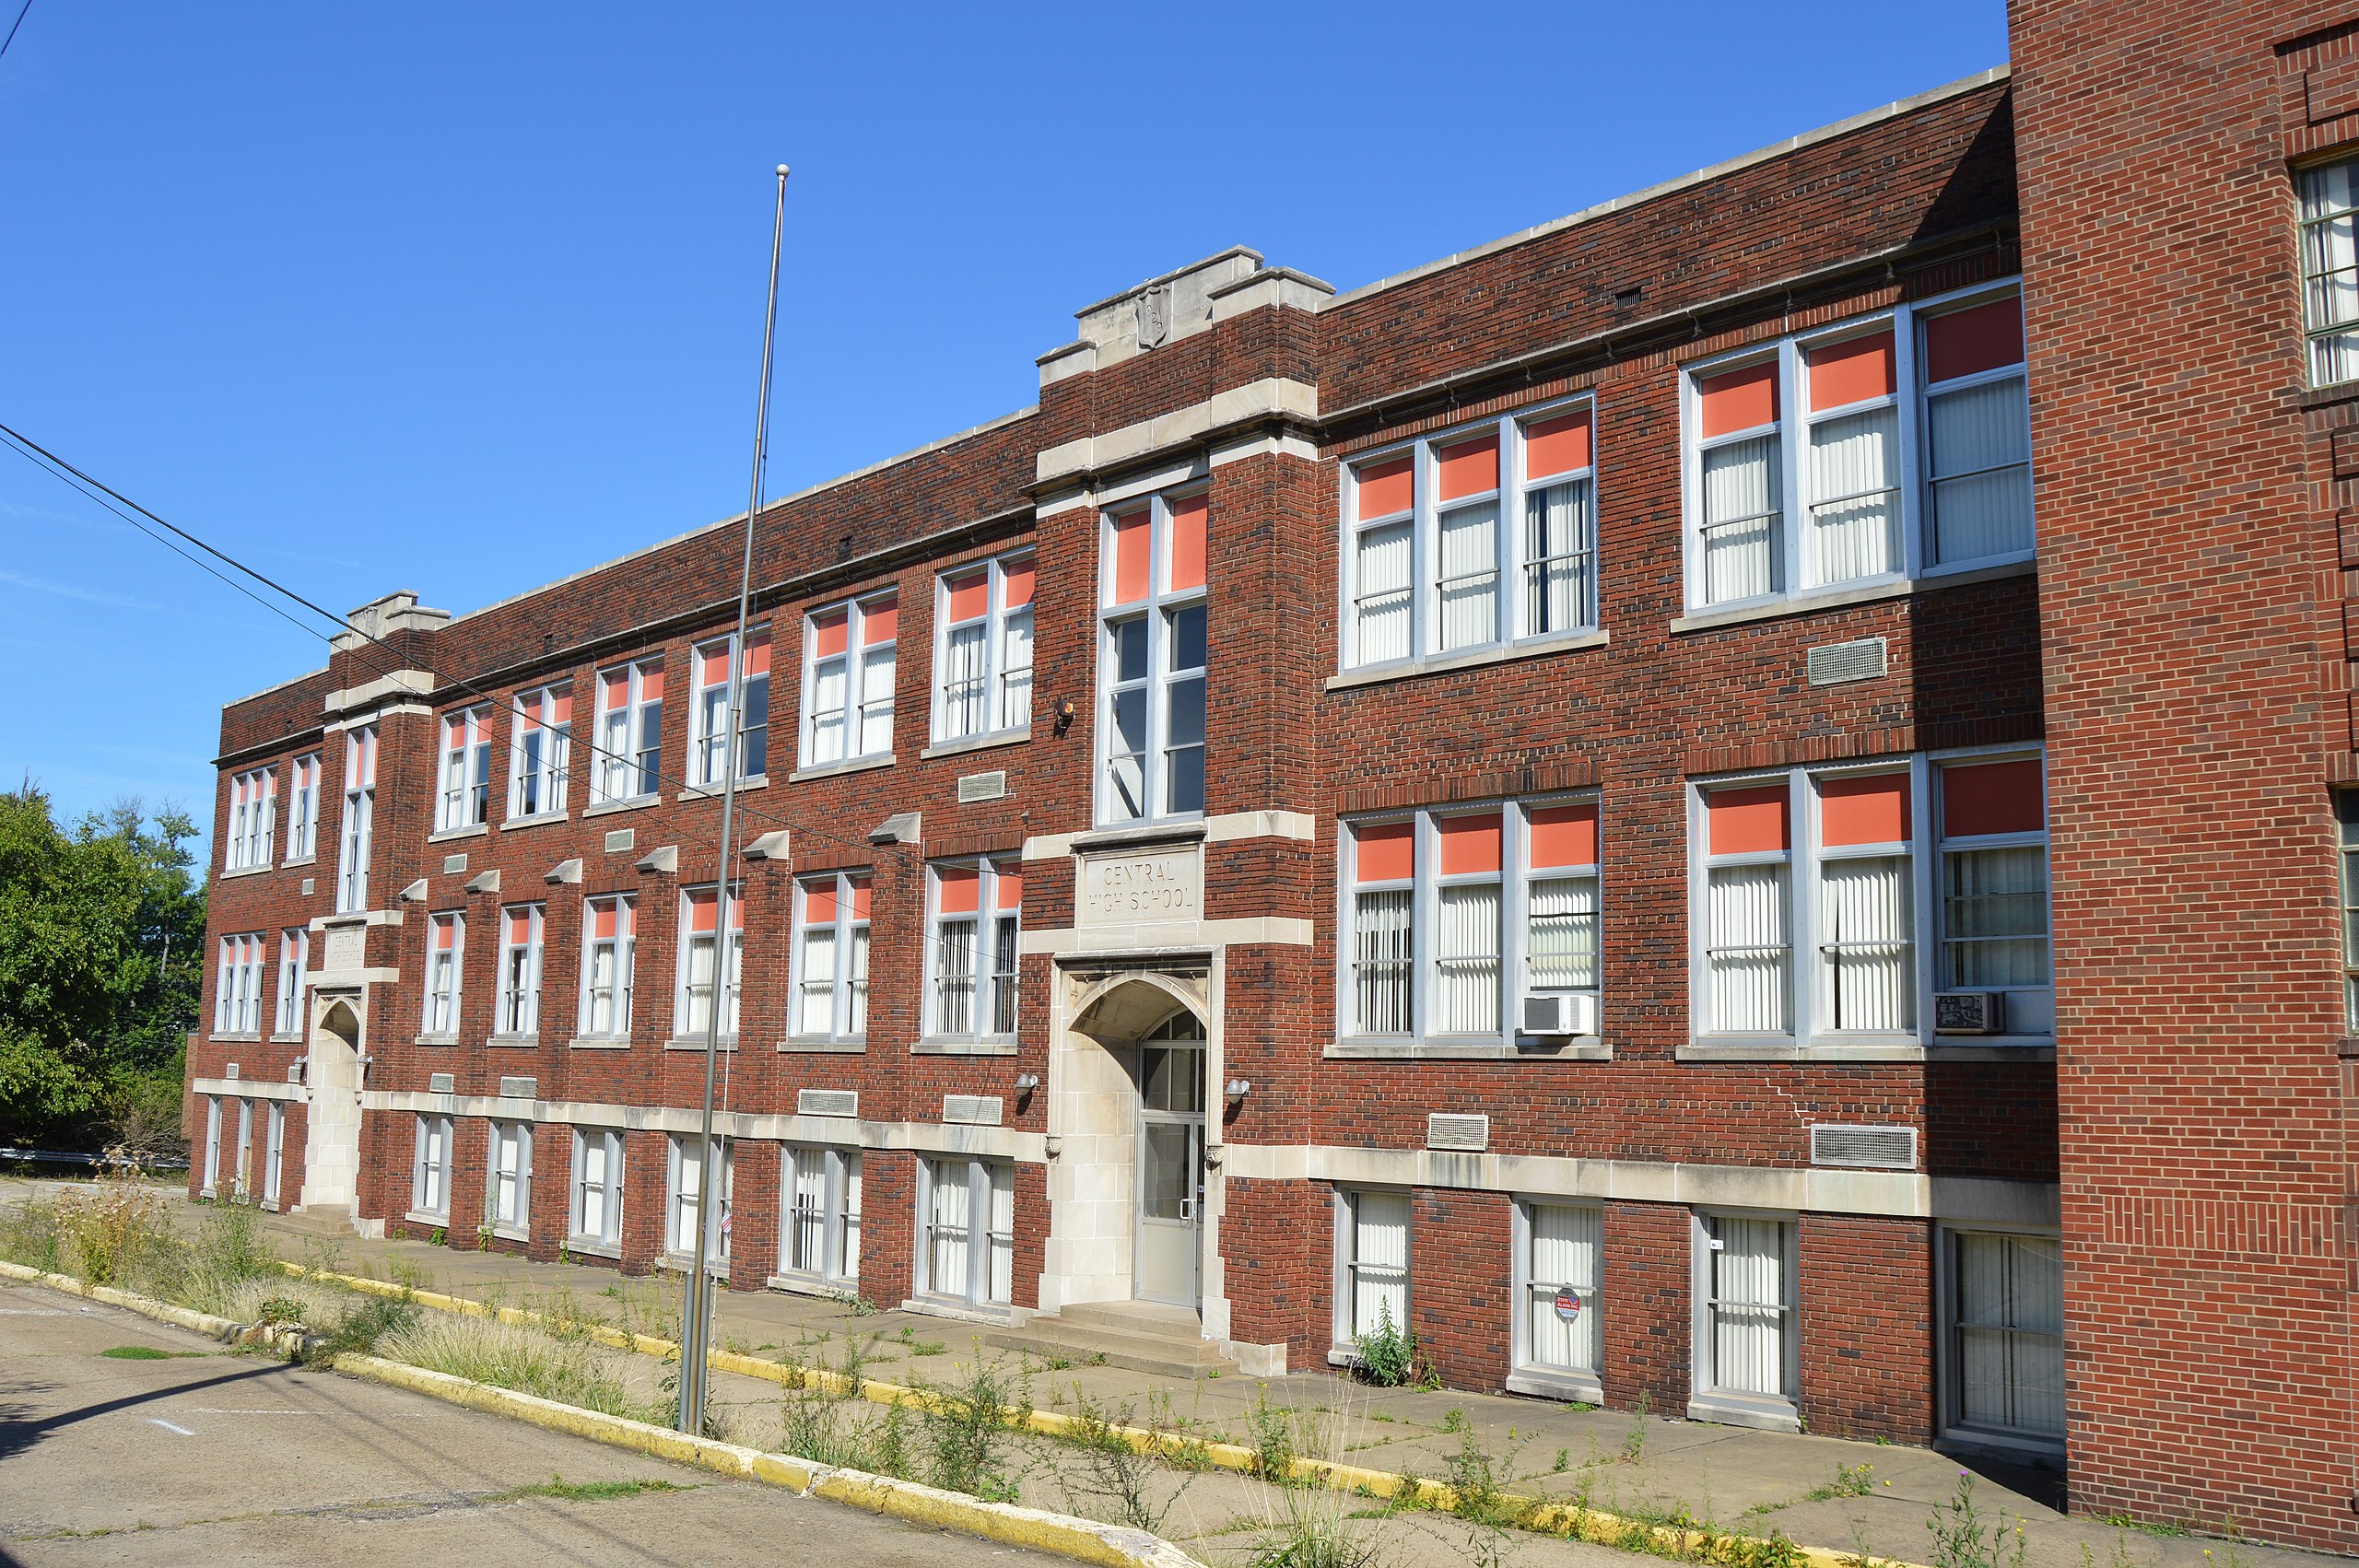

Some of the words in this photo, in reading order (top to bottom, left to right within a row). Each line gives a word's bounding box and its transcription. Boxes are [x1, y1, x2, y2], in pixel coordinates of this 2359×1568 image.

[1104, 861, 1175, 885] CENTRAL
[1089, 892, 1123, 912] HIGH
[1130, 888, 1192, 910] SCHOOL
